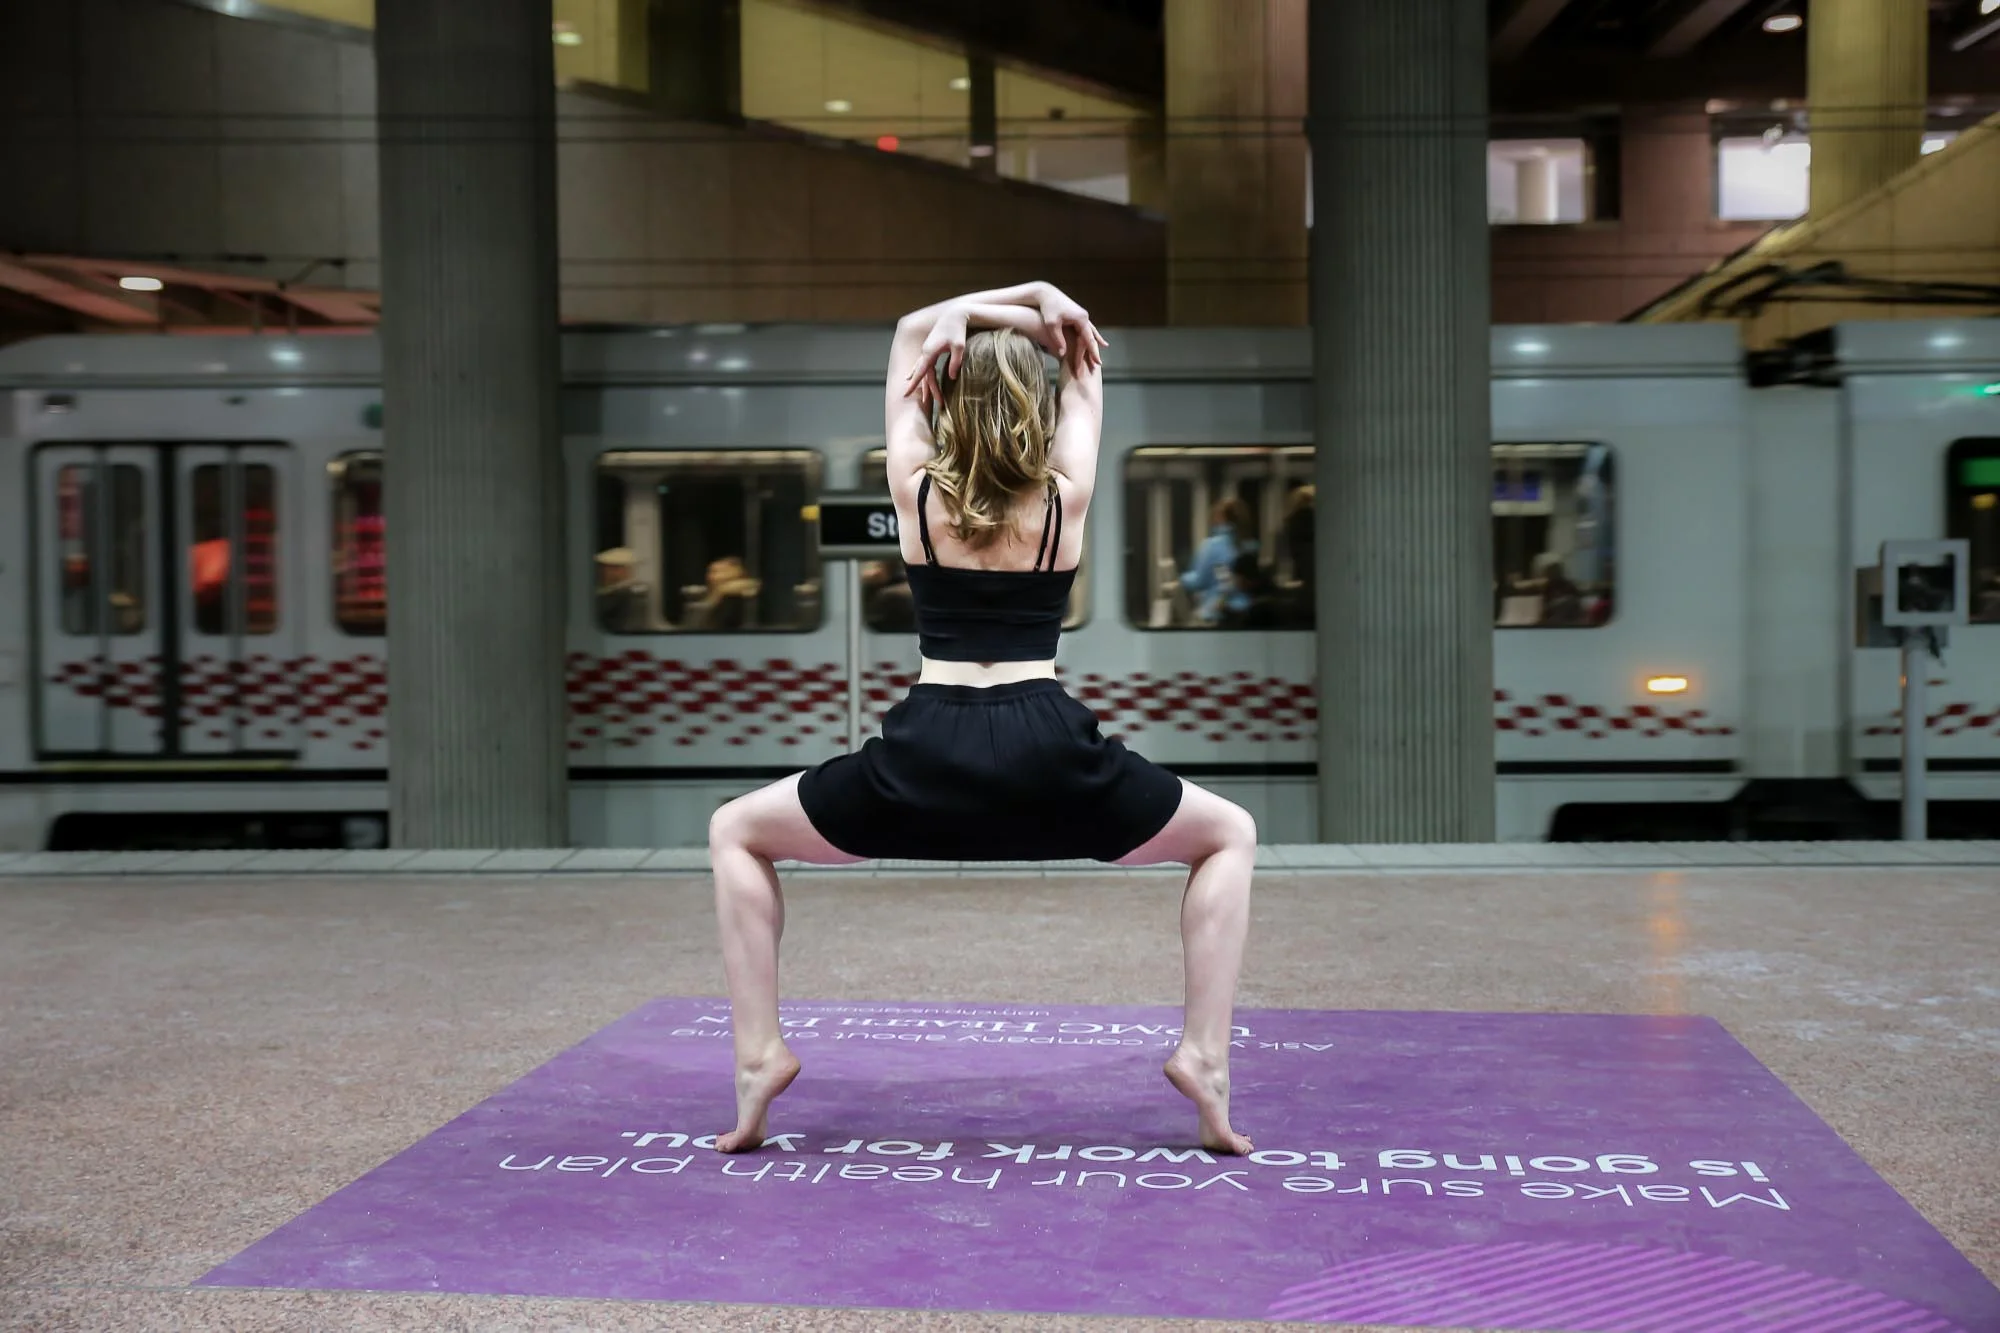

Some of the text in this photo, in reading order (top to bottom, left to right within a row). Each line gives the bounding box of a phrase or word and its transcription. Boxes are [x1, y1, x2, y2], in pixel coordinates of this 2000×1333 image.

[867, 512, 899, 537] St
[694, 1015, 826, 1028] PN
[838, 1018, 1041, 1033] HEALTH
[671, 1028, 1334, 1052] Ask yr company about ofing
[823, 1139, 955, 1161] for
[981, 1143, 1217, 1164] work
[1248, 1149, 1346, 1171] to
[1378, 1149, 1659, 1176] going
[1689, 1160, 1770, 1182] is
[499, 1154, 1790, 1211] Make sure your health plan
